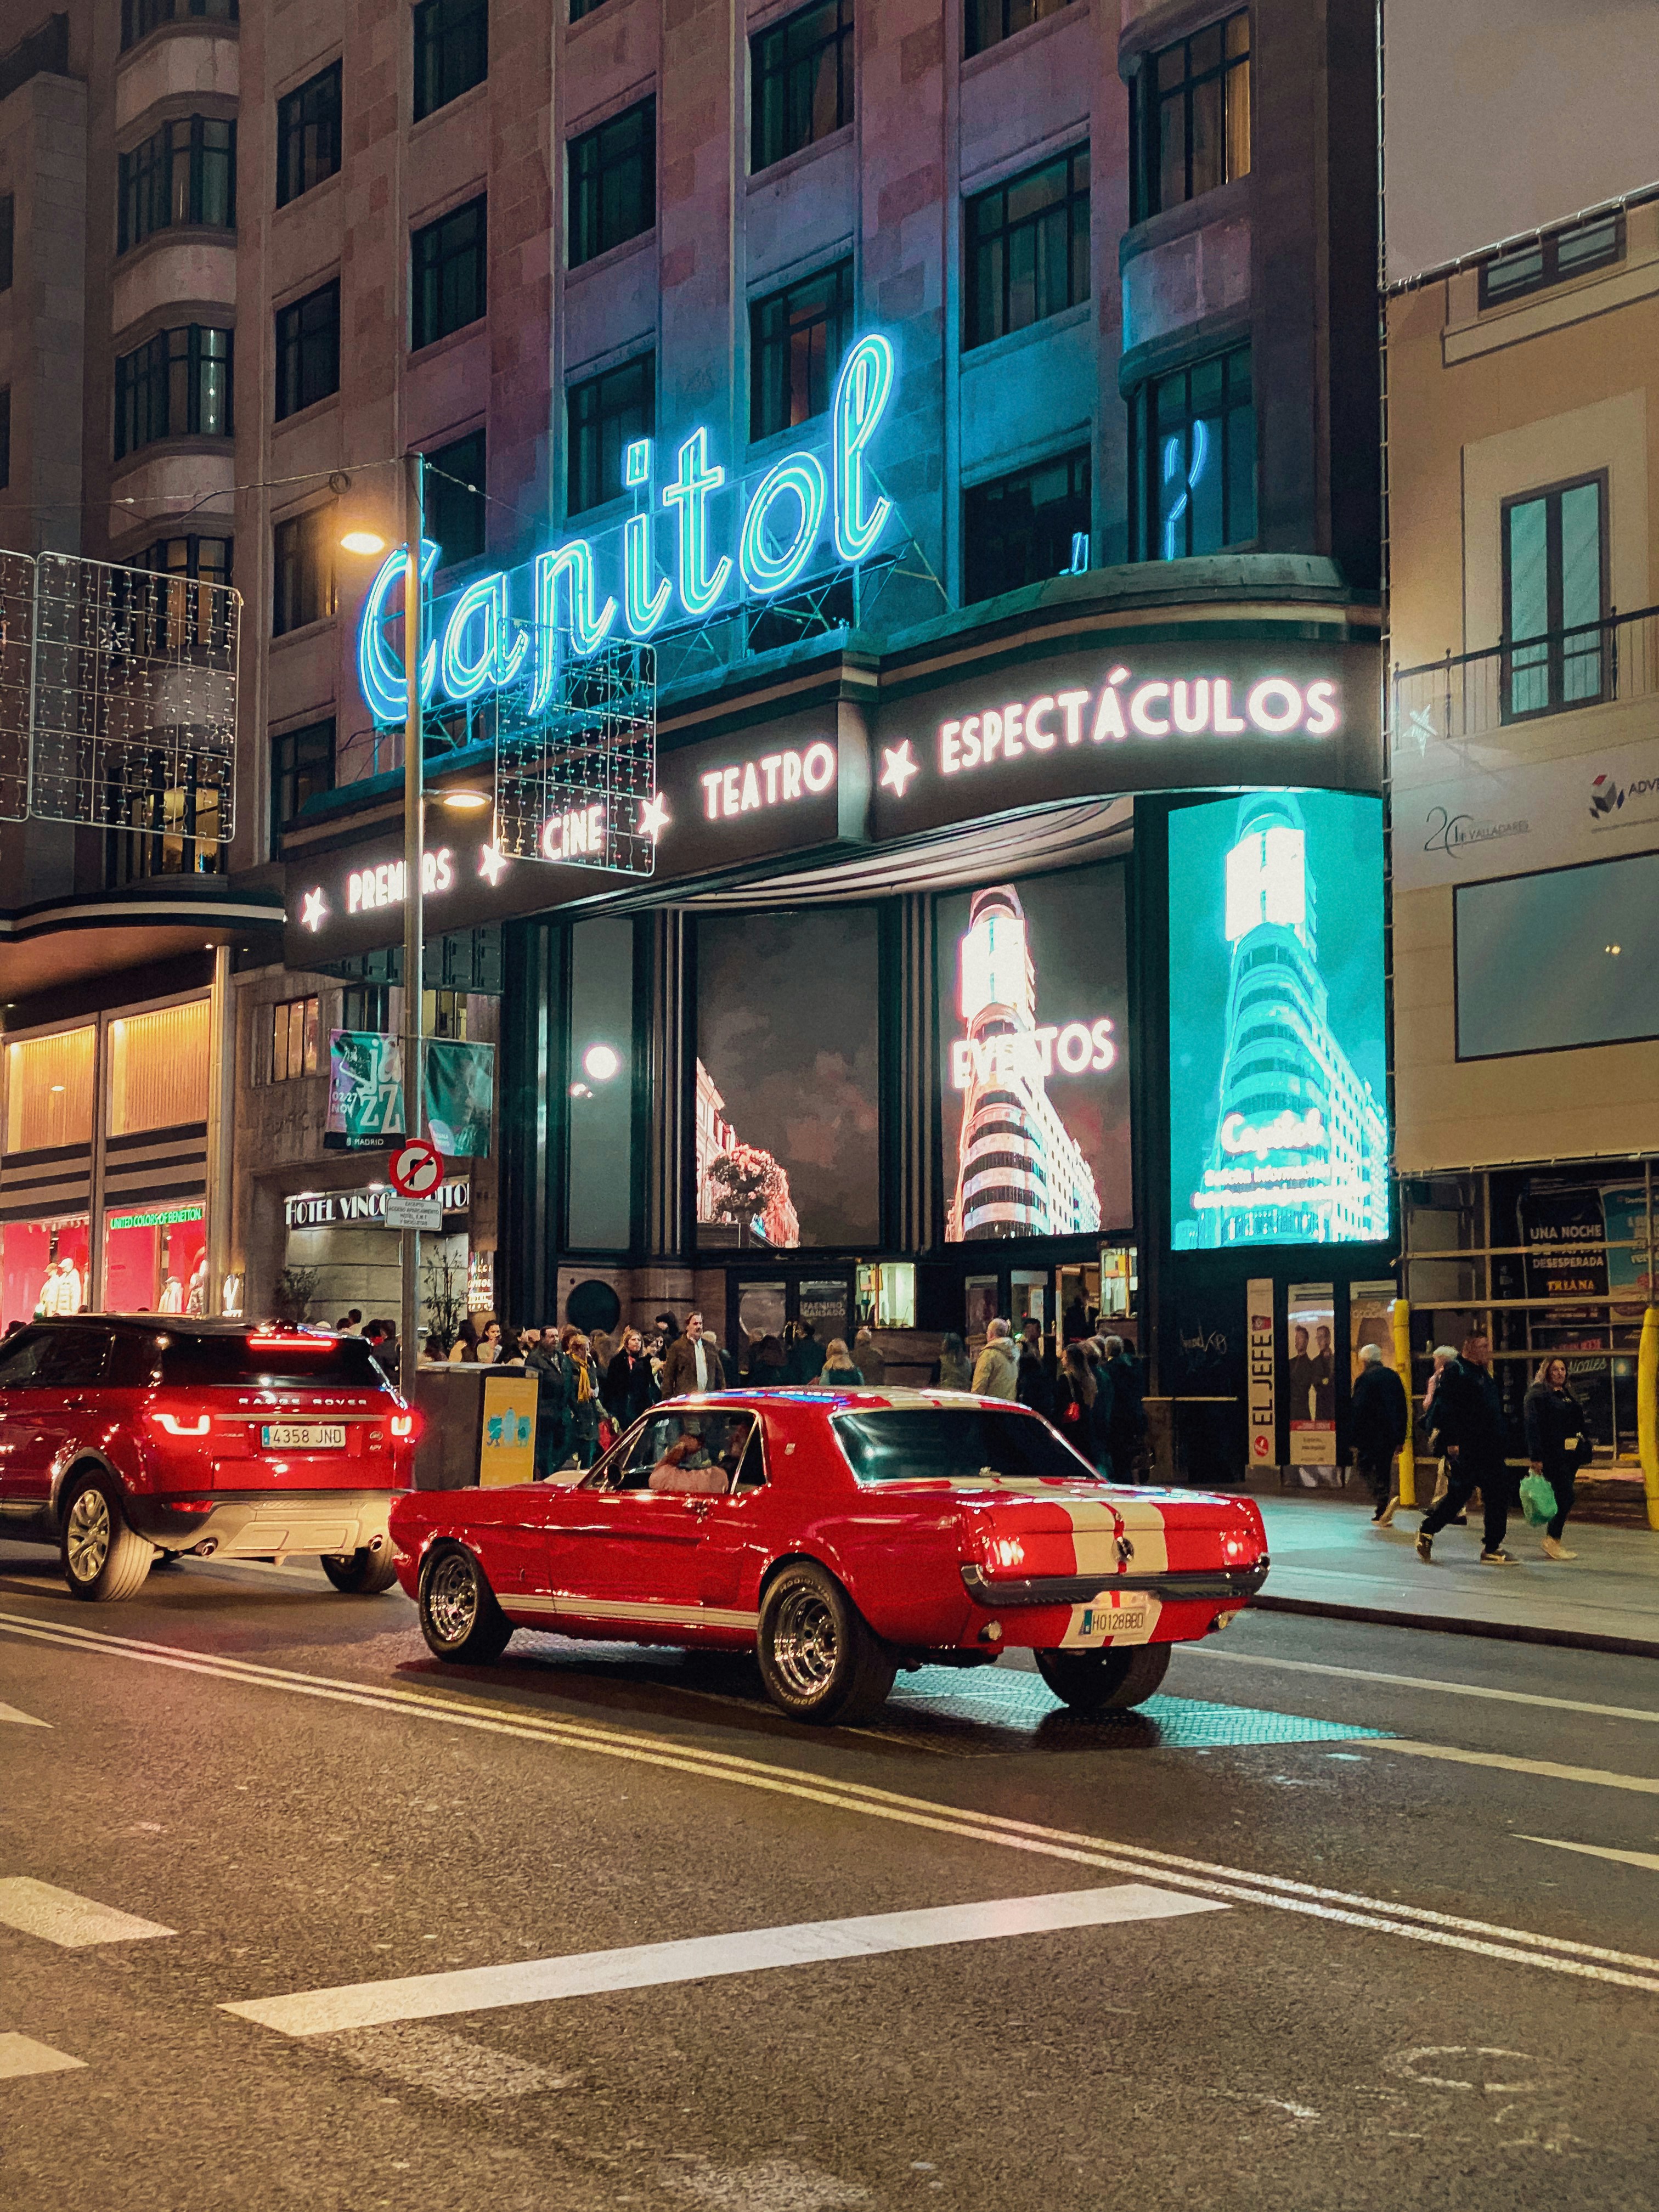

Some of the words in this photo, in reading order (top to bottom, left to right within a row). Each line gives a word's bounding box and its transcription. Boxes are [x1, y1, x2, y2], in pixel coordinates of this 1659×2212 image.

[358, 334, 895, 722] Capitol
[941, 667, 1337, 772] ESPECTÁCULOS
[349, 848, 450, 913] PREMRS
[543, 805, 603, 860] CINE
[703, 743, 834, 819] TEATRO
[354, 1137, 383, 1146] MADRID
[110, 1216, 133, 1229] UNITED
[133, 1213, 158, 1227] COLORS
[157, 1212, 168, 1225] OF
[285, 1199, 336, 1225] HOTEL
[340, 1192, 397, 1220] VINCC
[1530, 1226, 1558, 1239] UNA
[1561, 1224, 1602, 1239] NOCHE
[1533, 1256, 1604, 1268] DESESPERADA
[1251, 1334, 1273, 1391] JEFE
[1252, 1398, 1273, 1426] EL
[273, 1429, 310, 1443] 4358
